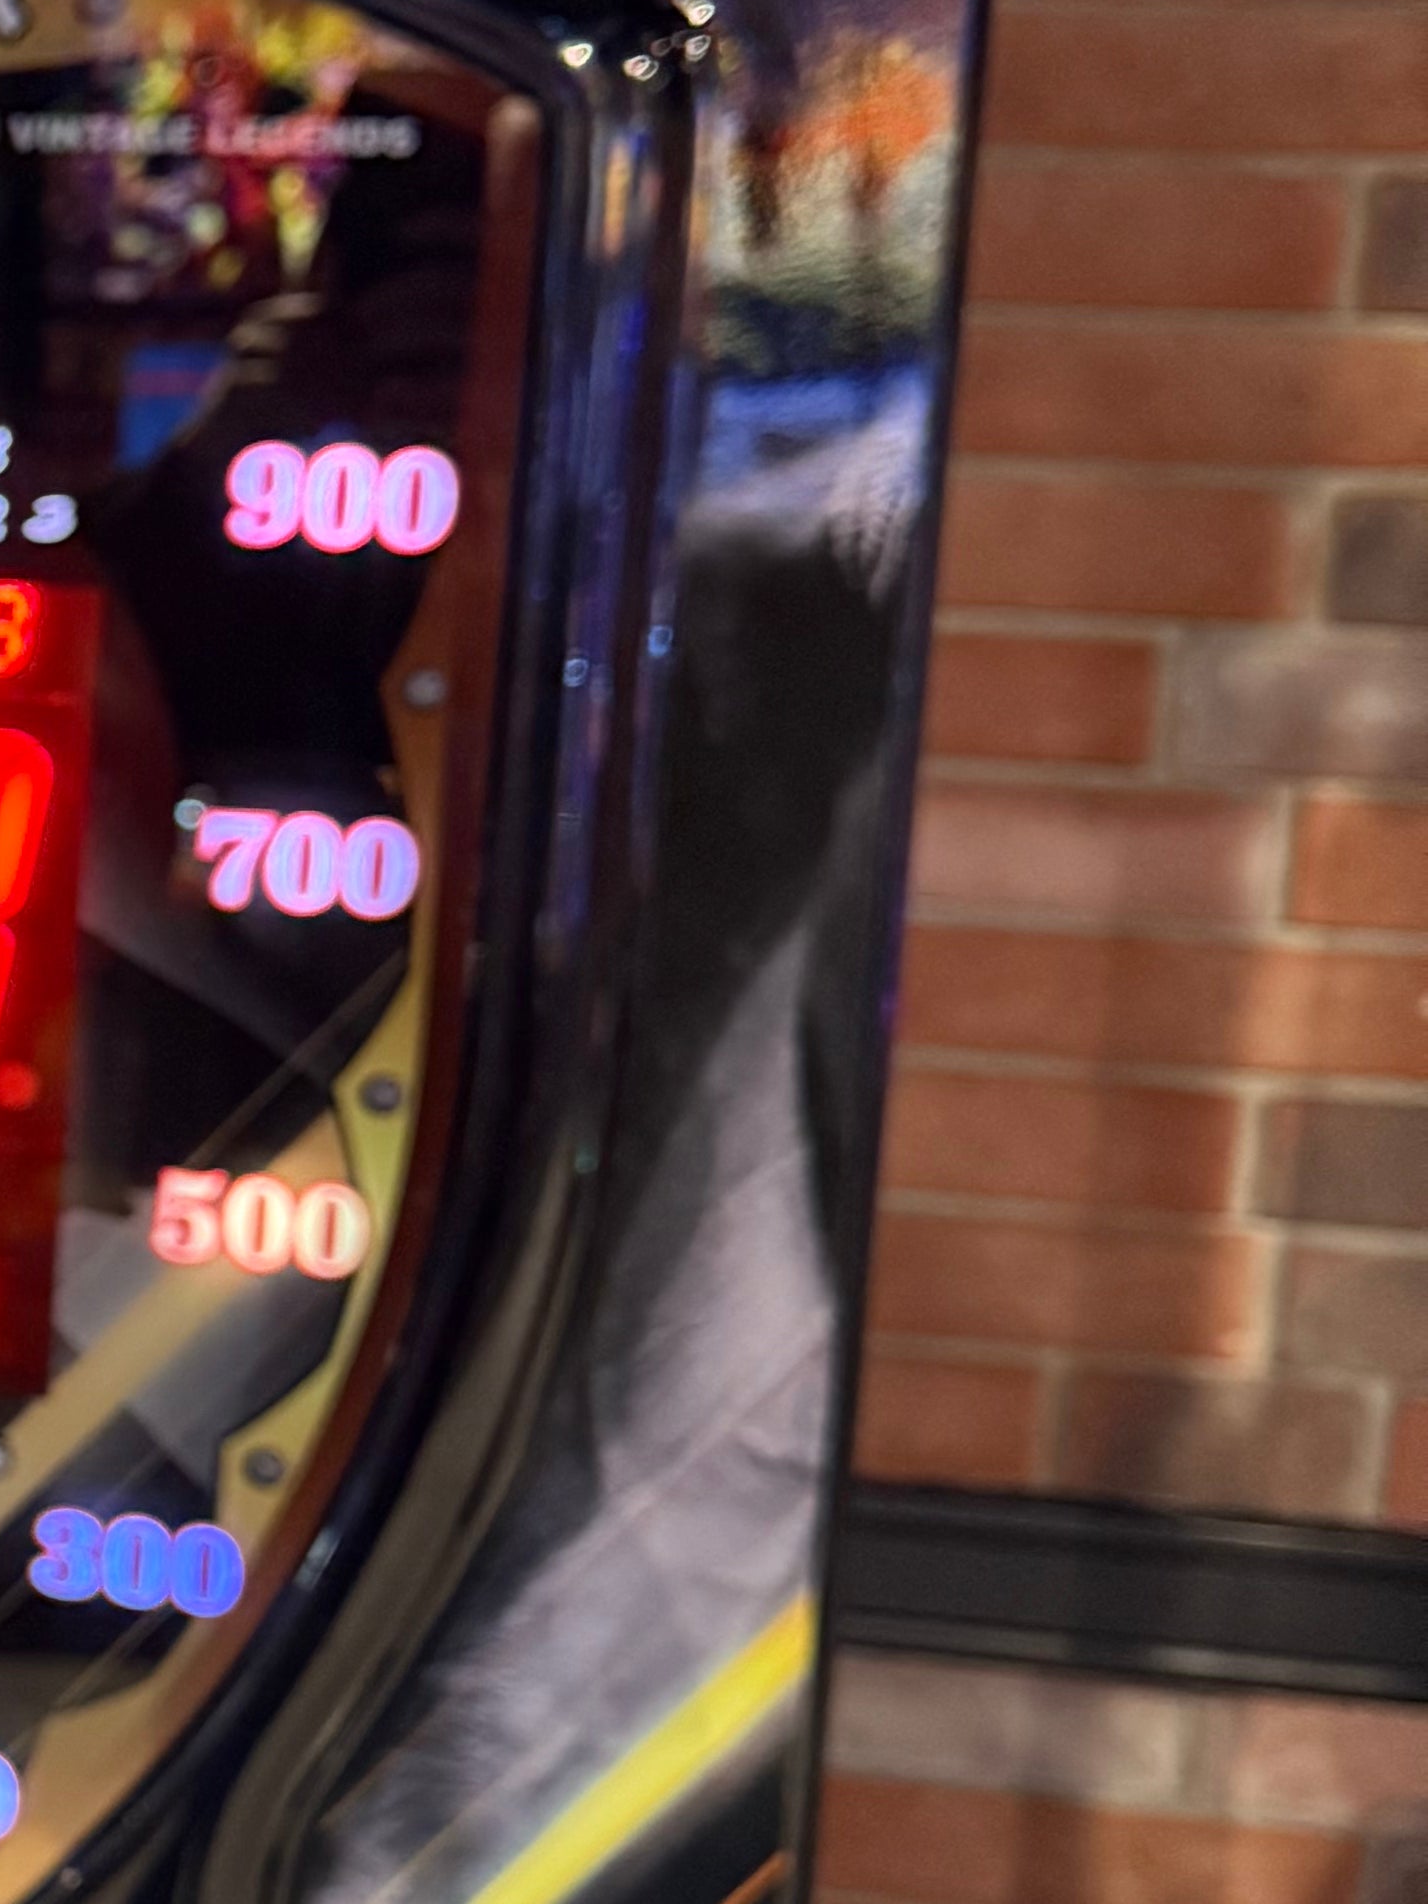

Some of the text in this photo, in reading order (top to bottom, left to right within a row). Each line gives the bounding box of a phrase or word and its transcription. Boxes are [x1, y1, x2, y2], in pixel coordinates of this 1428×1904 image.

[222, 439, 461, 556] 900
[192, 804, 422, 924] 700
[145, 1167, 374, 1283] 500
[29, 1504, 250, 1620] 300
